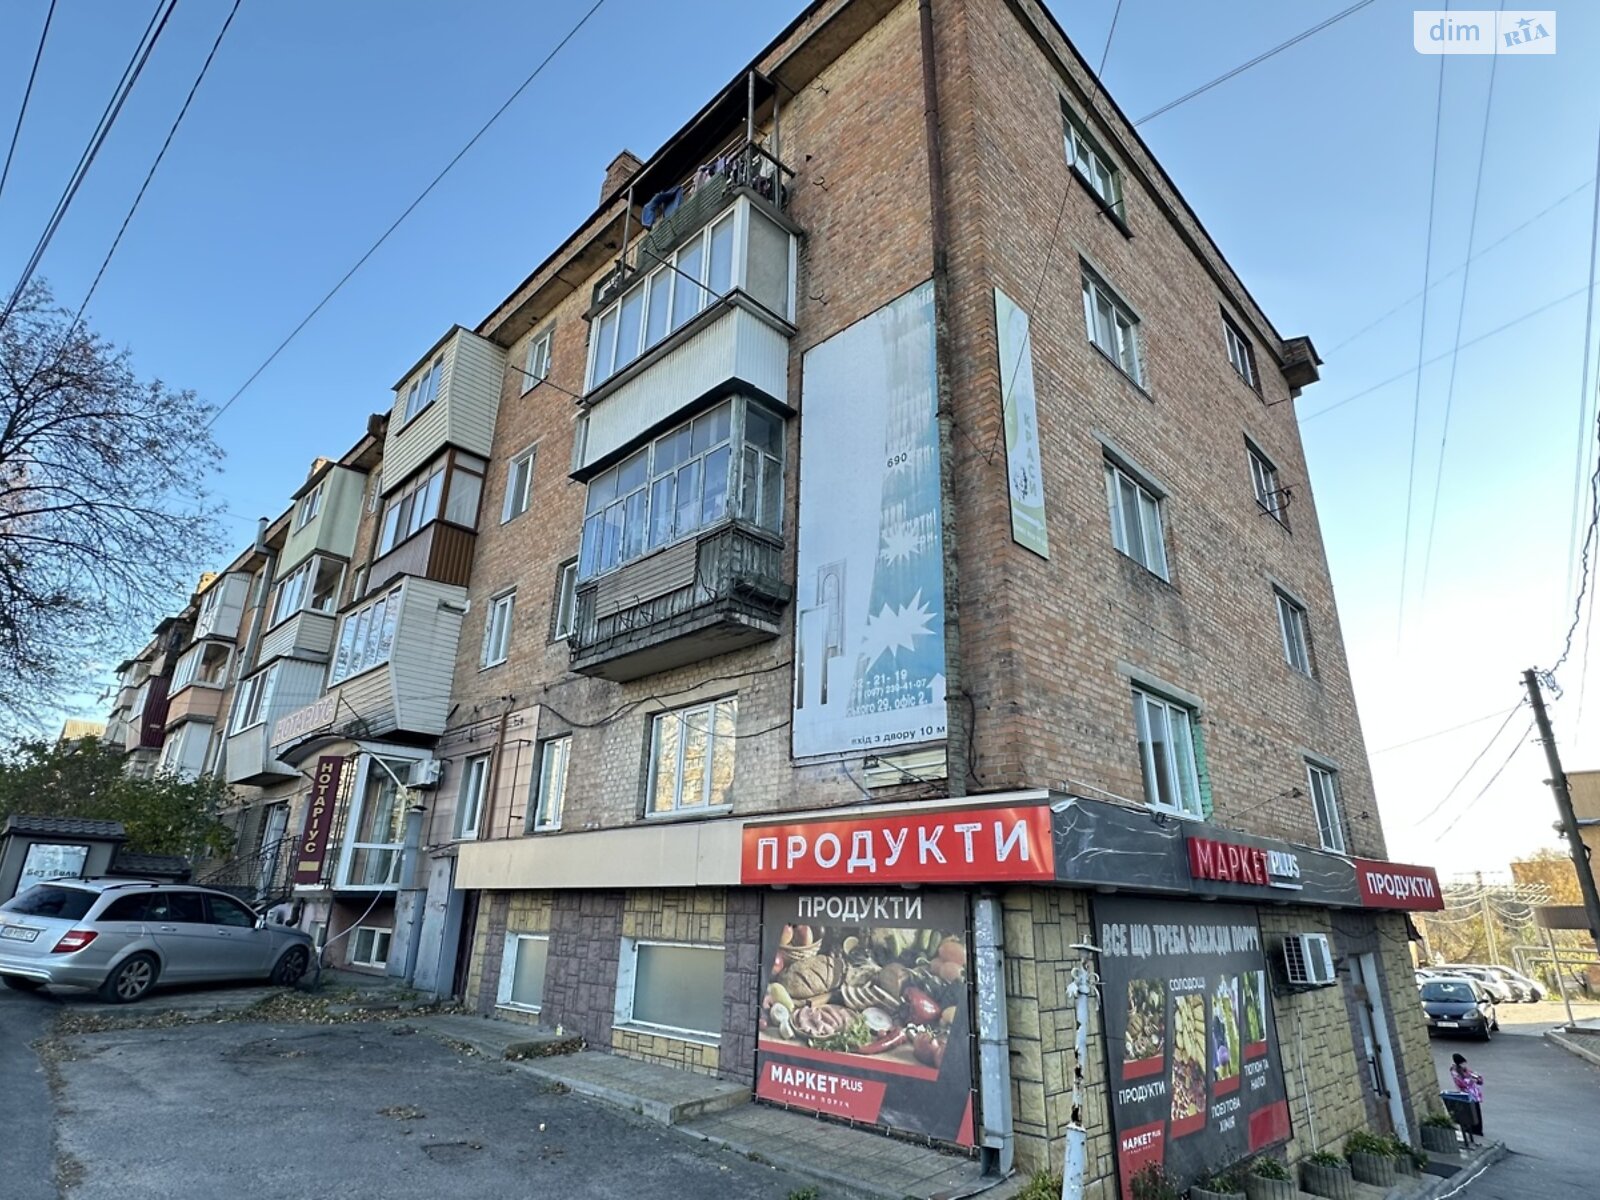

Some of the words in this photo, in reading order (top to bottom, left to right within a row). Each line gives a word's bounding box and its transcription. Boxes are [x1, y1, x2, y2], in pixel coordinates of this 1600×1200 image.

[887, 452, 908, 468] 690
[895, 669, 908, 681] 19
[894, 695, 916, 710] офіс
[874, 735, 880, 743] з
[883, 729, 916, 743] двору
[920, 725, 933, 736] 10
[304, 762, 333, 853] НОТАРІУС
[757, 819, 1030, 873] ПРОДУКТИ
[1193, 840, 1269, 885] МАРКЕТ
[1270, 849, 1300, 878] PLUS
[1366, 871, 1435, 901] ПРОДУКТИ
[798, 896, 923, 922] ПРОДУКТИ
[1102, 923, 1128, 957] ВСЕ
[1130, 923, 1151, 959] ЩО
[1153, 924, 1189, 956] ТРЕБА
[1188, 925, 1232, 956] ЗАВЖДИ
[771, 1064, 838, 1094] МАРКЕТ
[841, 1078, 863, 1092] PLUS
[1118, 1082, 1165, 1105] ПРОДУКТИ
[1122, 1132, 1152, 1152] МАРКЕТ
